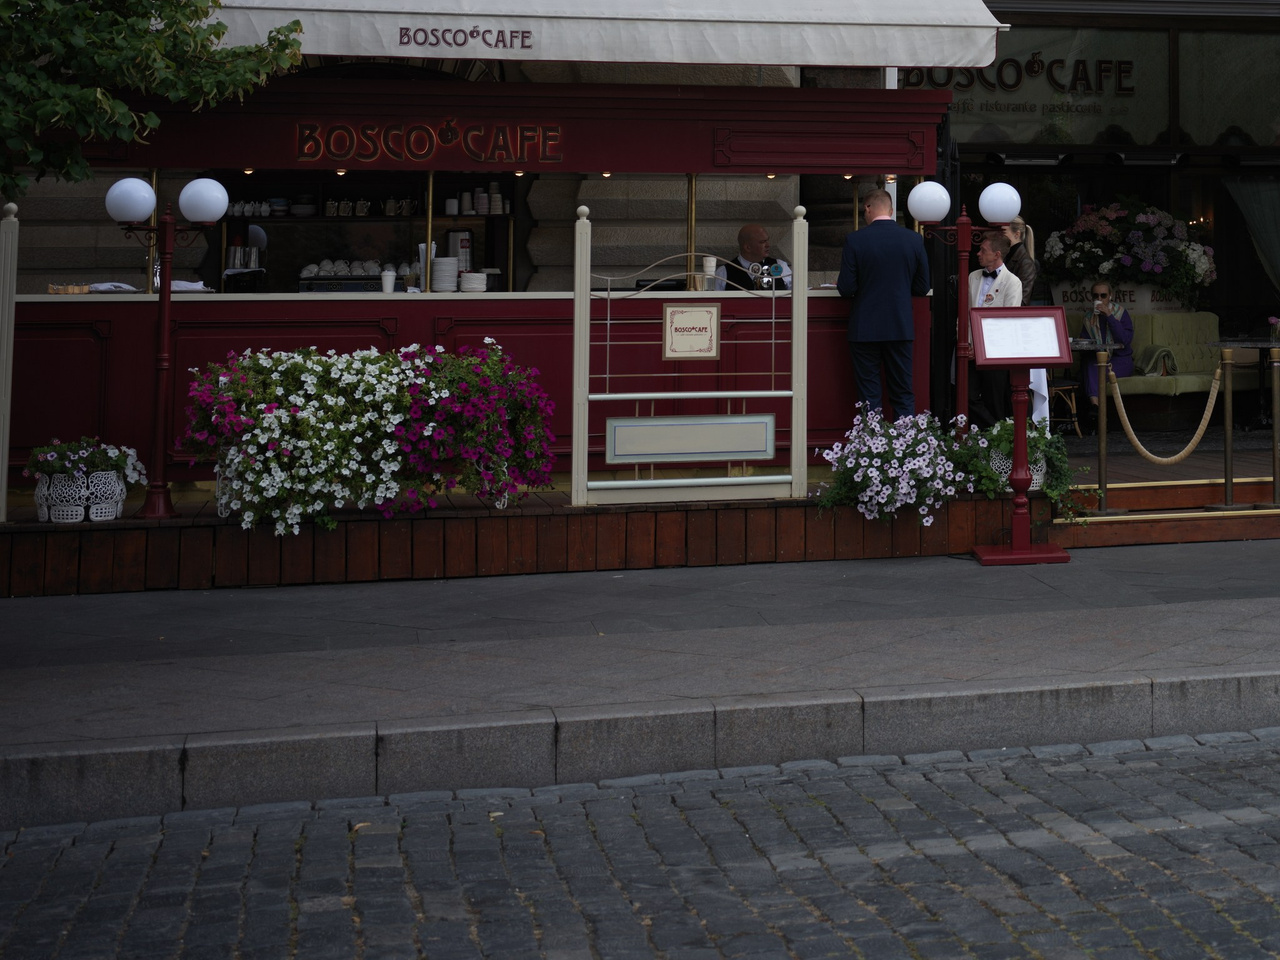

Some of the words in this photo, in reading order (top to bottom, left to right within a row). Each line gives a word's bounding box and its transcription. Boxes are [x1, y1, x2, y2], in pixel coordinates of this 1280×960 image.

[399, 27, 469, 47] BOSCO
[481, 30, 533, 50] CAFE
[1046, 59, 1135, 94] CAFE
[950, 98, 975, 114] affè
[980, 100, 1037, 113] ristorante
[297, 123, 436, 161] BOSCO
[461, 125, 563, 163] CAFE
[1062, 290, 1092, 303] BOSC
[1111, 290, 1136, 303] AFE
